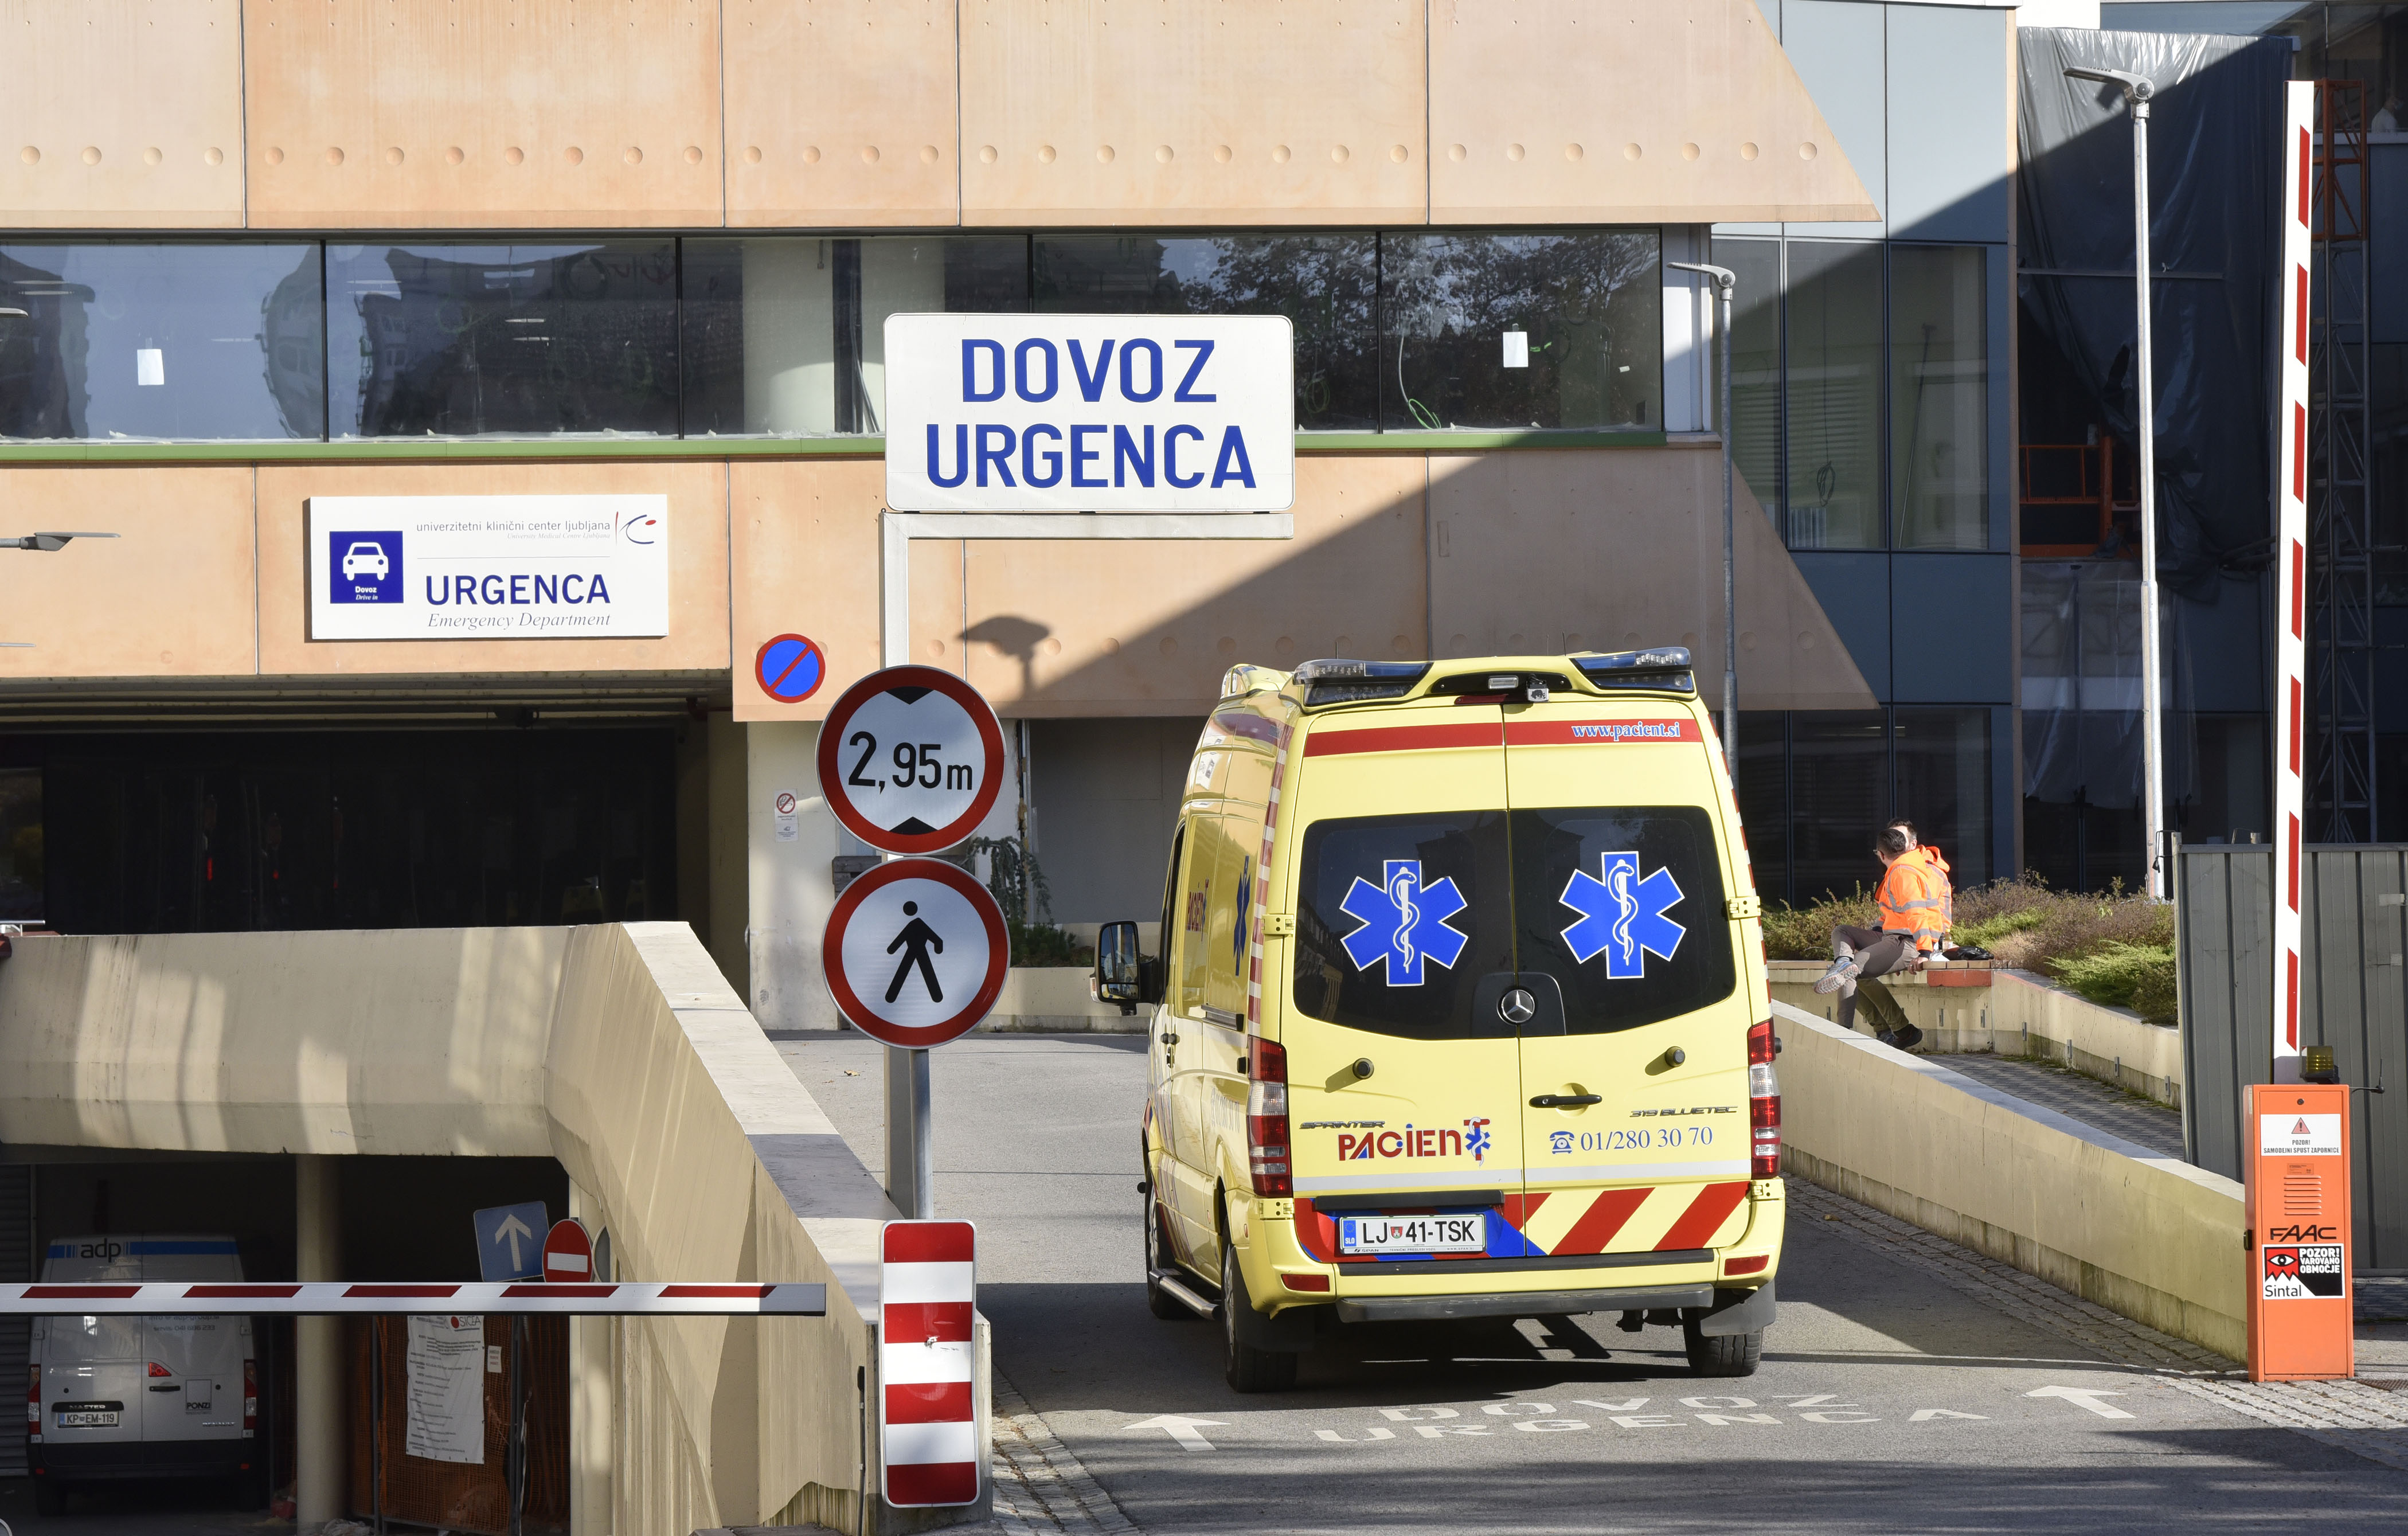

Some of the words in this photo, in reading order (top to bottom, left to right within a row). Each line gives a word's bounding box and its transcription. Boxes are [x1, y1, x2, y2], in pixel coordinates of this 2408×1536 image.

[961, 338, 1217, 403] DOVOZ
[927, 423, 1257, 488] URGENCA
[416, 521, 482, 531] univerzitetni
[486, 520, 524, 531] klinični
[528, 521, 561, 531] center
[565, 520, 611, 533] ljubljana
[426, 574, 611, 605] URGENCA
[428, 612, 514, 630] Emergency
[519, 612, 611, 628] Department
[1572, 721, 1680, 741] www.pacient.si
[1629, 1108, 1659, 1117] 319
[1660, 1106, 1738, 1116] BLUETEC
[1299, 1120, 1386, 1129] SPRINTER
[1581, 1129, 1651, 1151] 01/280
[1657, 1128, 1682, 1148] 30
[1688, 1125, 1713, 1146] 70
[1363, 1222, 1388, 1244] LJ
[1406, 1220, 1476, 1243] 41-TSK
[2270, 1225, 2337, 1242] FAAC
[80, 1238, 122, 1263] adp
[2299, 1248, 2340, 1257] POZOR!
[2300, 1264, 2340, 1273] OBMOČJE
[2265, 1285, 2301, 1297] Sintal
[459, 1316, 481, 1327] SICEA
[1378, 1394, 1860, 1421] DOVOZ
[67, 1414, 79, 1424] KP
[85, 1413, 115, 1423] EM-119
[1312, 1409, 1992, 1442] URGENCA
